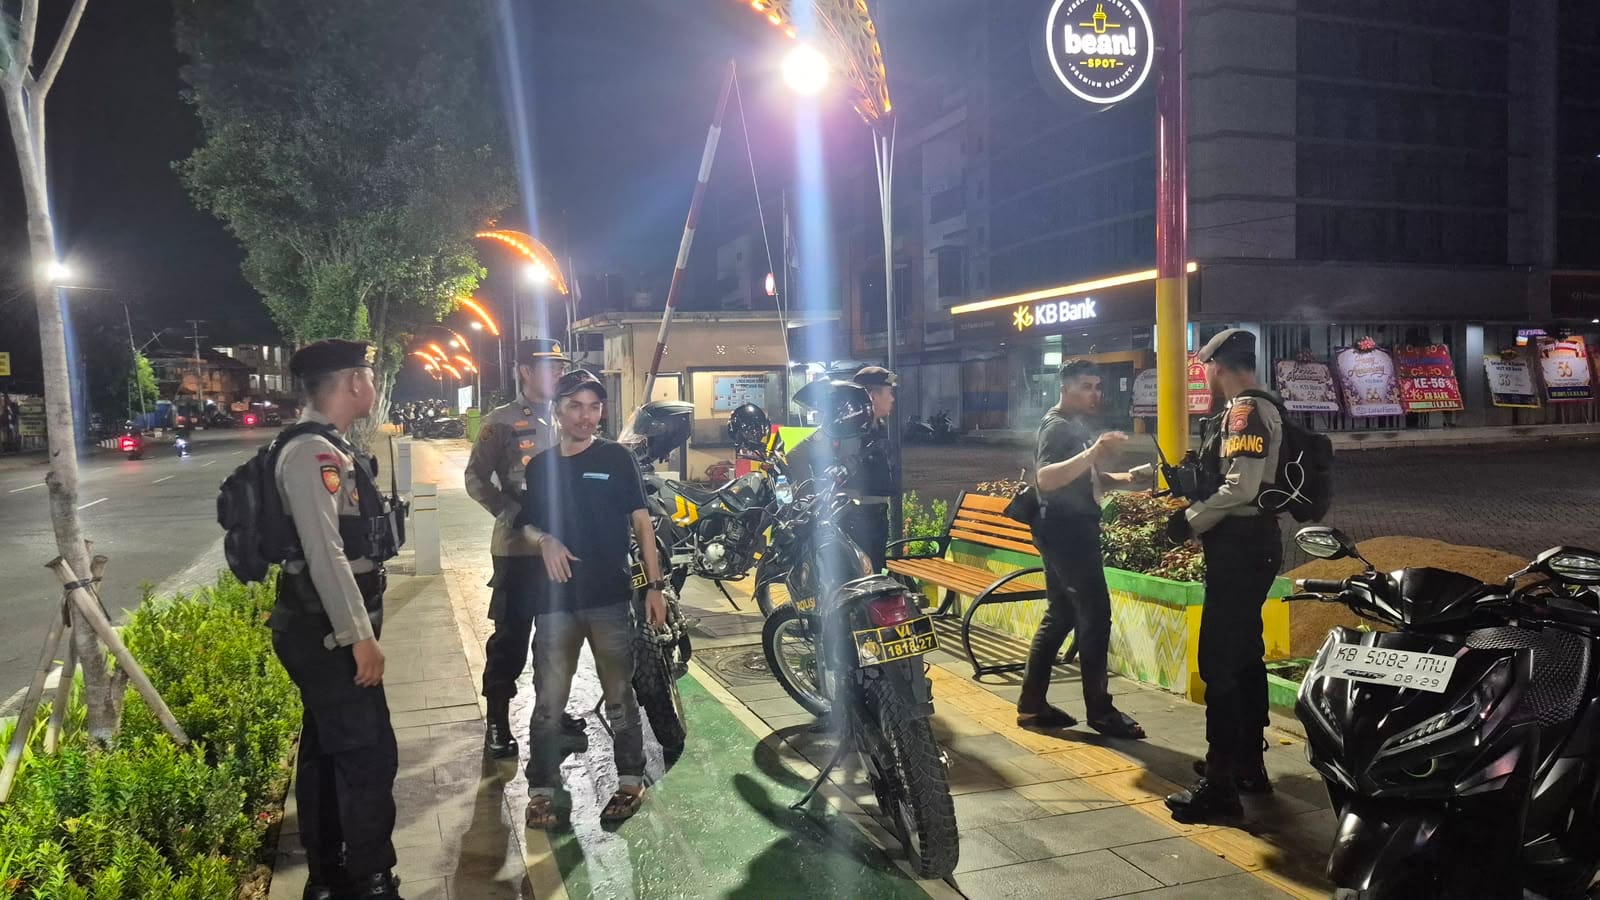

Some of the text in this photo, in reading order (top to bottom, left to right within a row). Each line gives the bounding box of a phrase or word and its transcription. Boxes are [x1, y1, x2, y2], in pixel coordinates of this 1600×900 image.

[1064, 24, 1137, 57] bean!
[1087, 58, 1117, 69] SPOT
[1070, 65, 1133, 89] PREMIUM QUALITY
[1035, 297, 1097, 326] KB Bank
[1413, 377, 1446, 389] KE-56
[1335, 647, 1448, 674] KB 5082 MU
